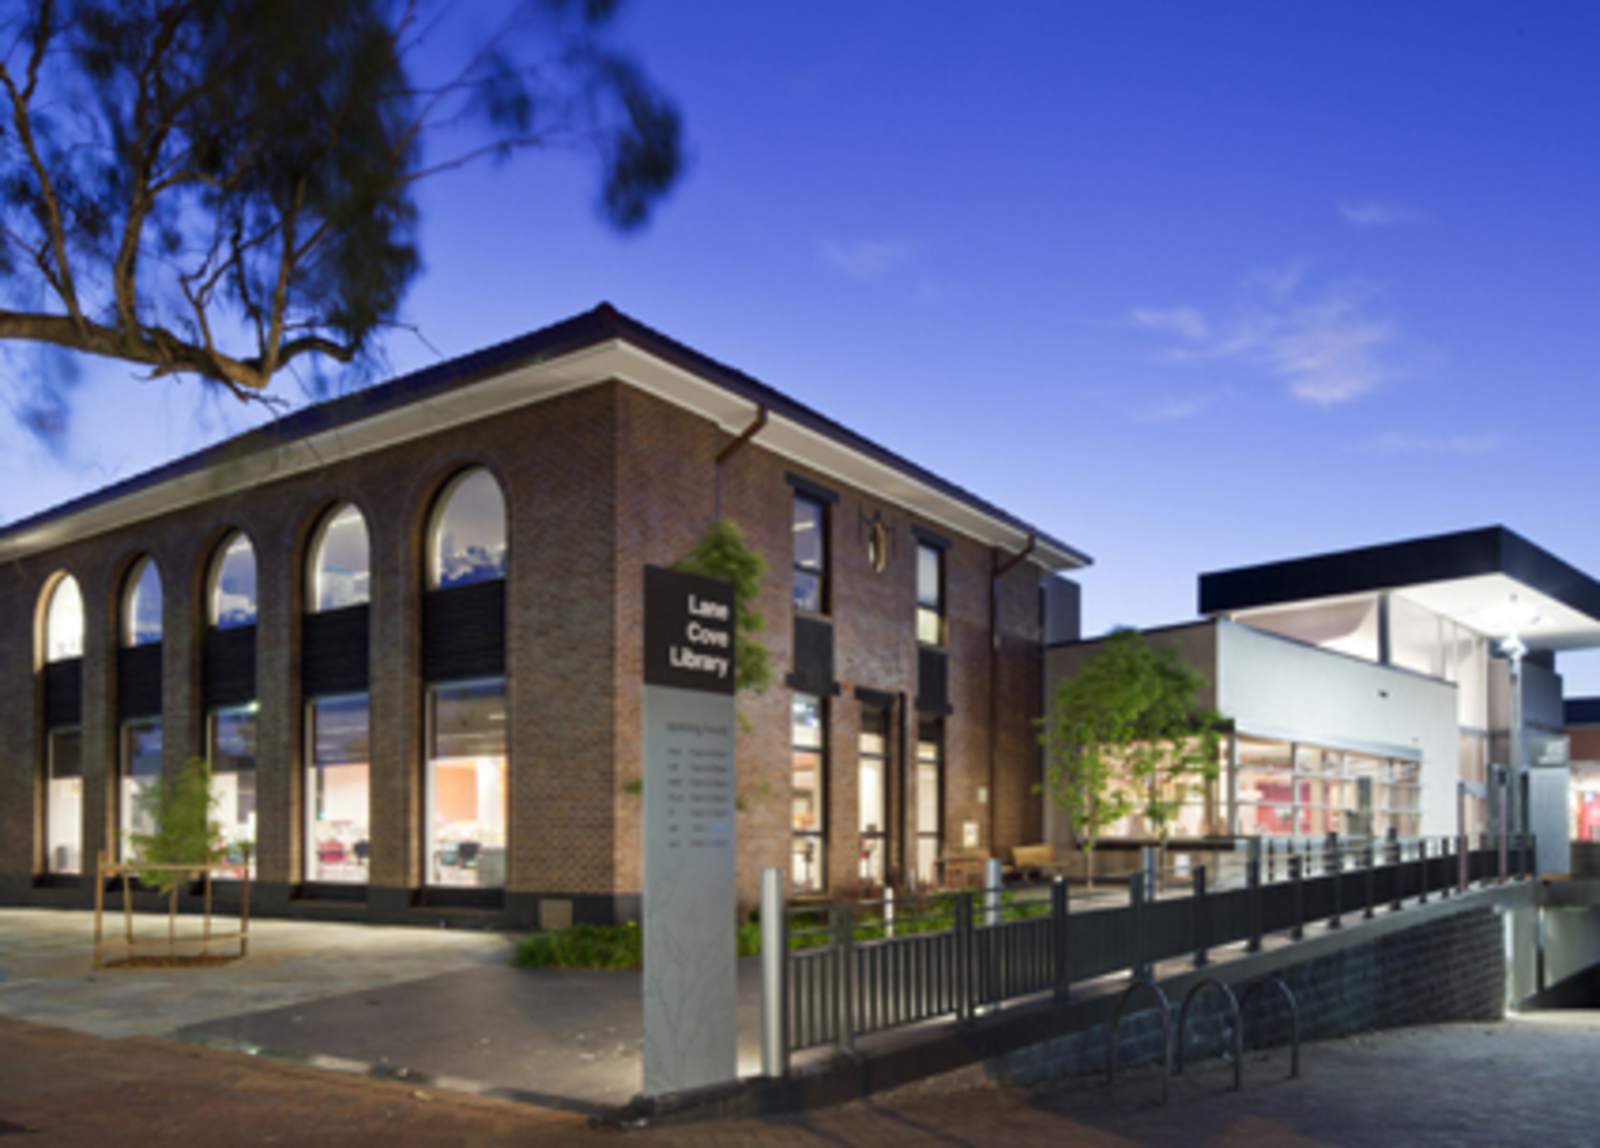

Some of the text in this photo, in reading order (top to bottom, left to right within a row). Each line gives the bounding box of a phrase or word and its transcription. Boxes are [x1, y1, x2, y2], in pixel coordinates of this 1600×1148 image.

[688, 594, 730, 621] Lane
[686, 622, 730, 648] Cove
[669, 645, 729, 678] Library
